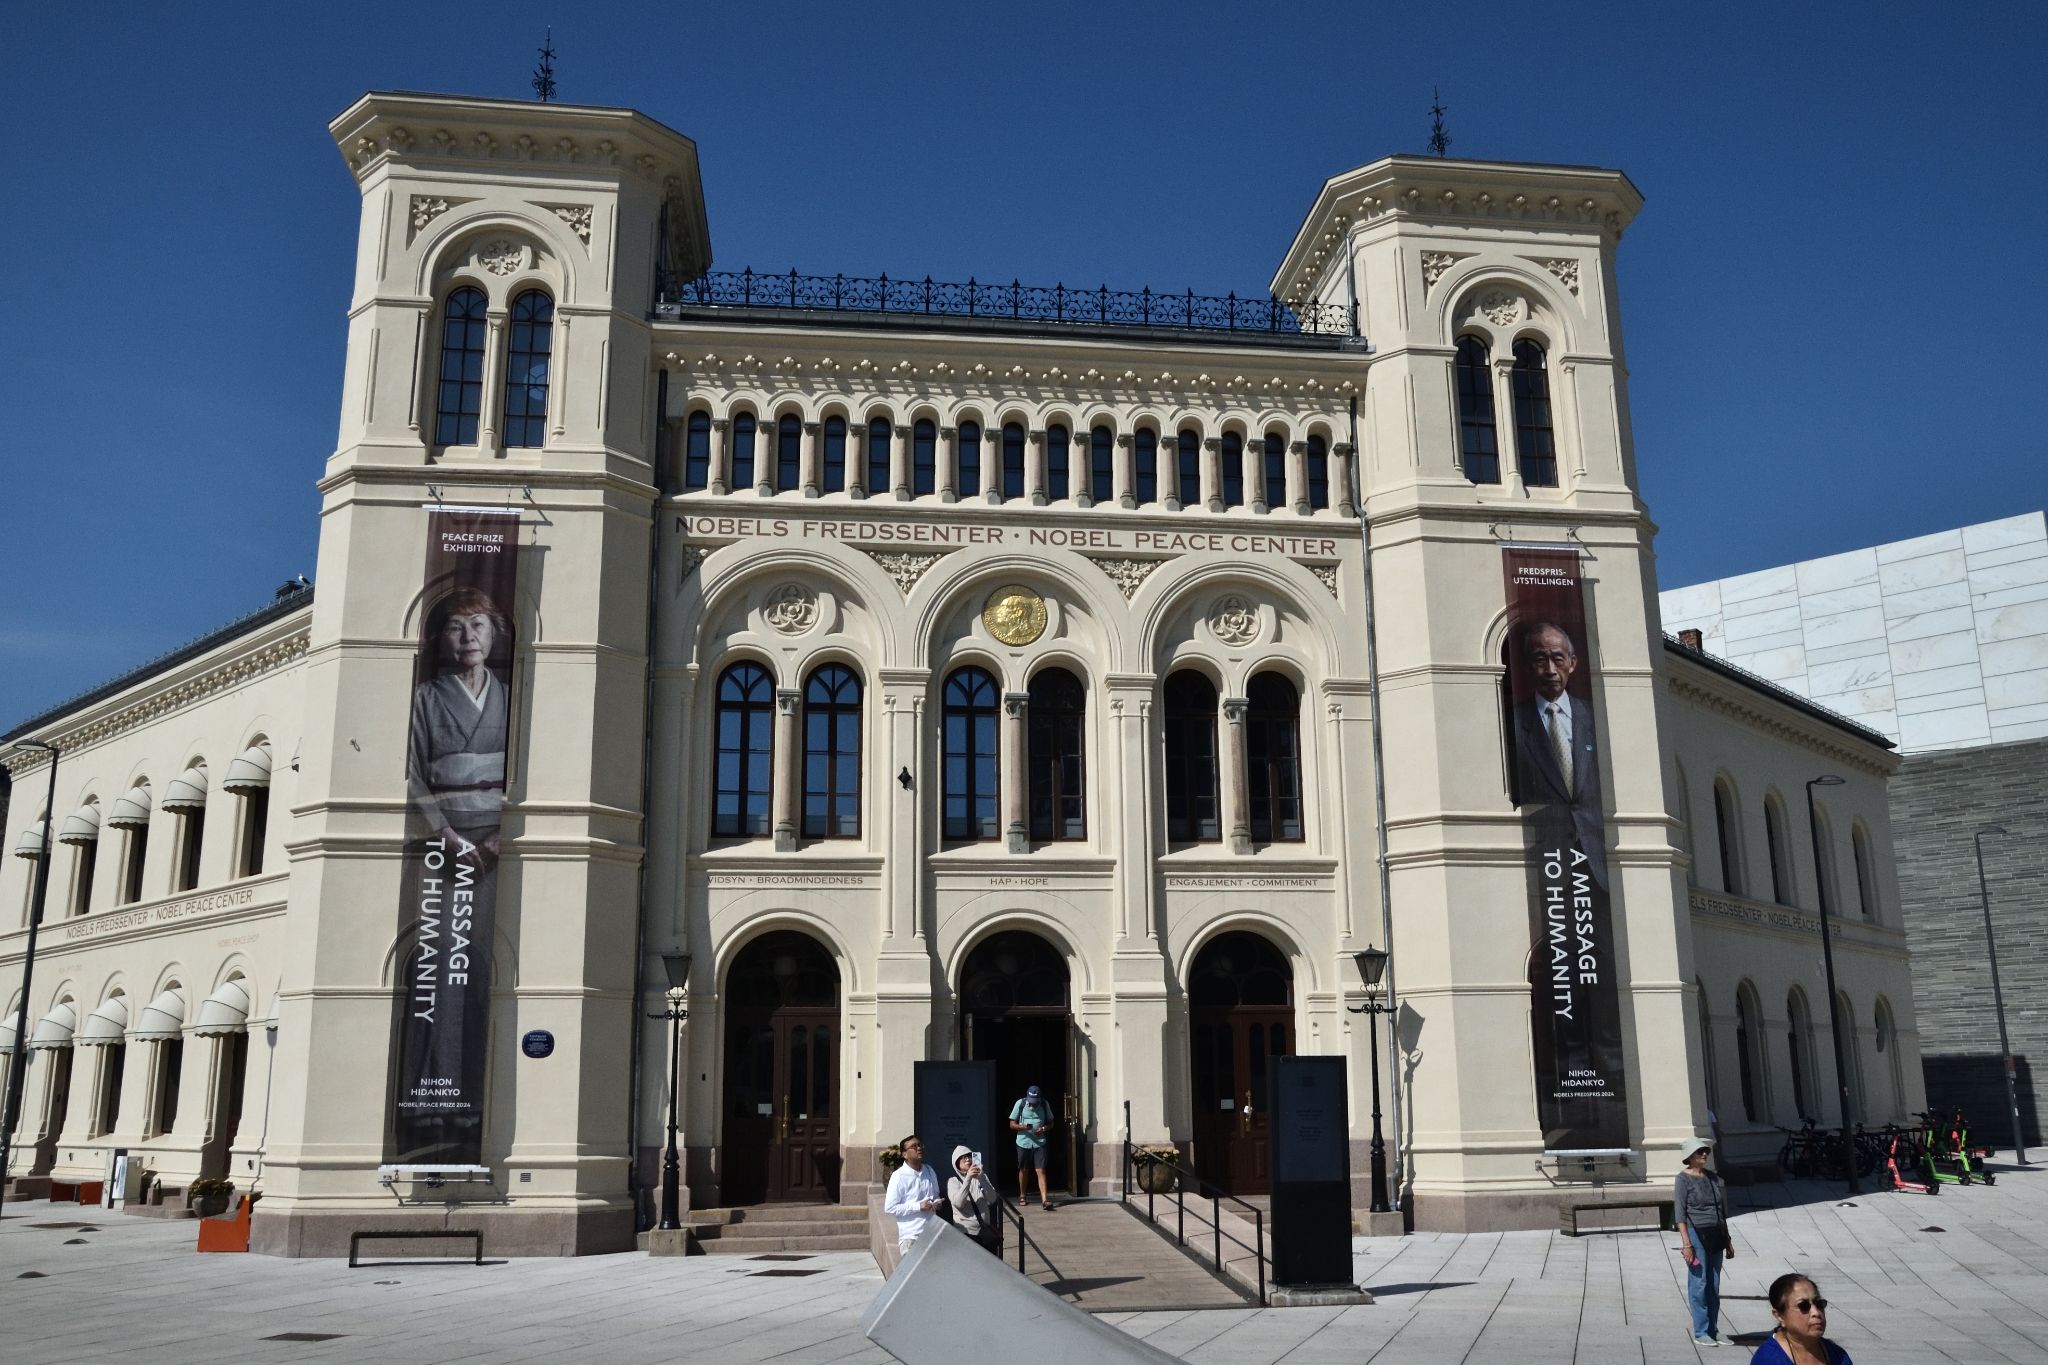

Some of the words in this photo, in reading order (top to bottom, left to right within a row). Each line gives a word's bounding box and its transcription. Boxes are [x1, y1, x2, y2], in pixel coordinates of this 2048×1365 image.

[441, 532, 475, 542] PEACE
[476, 534, 505, 543] PRIZE
[676, 516, 789, 537] NOBELS
[803, 521, 1004, 545] FREDSSENTER
[1029, 528, 1122, 548] NOBEL
[1135, 532, 1224, 551] PEACE
[1231, 536, 1336, 556] CENTER
[443, 543, 501, 553] EXHIBITION
[1518, 567, 1567, 576] FREDSPRIS-
[1513, 577, 1574, 586] UTSTILLINGEN
[424, 837, 446, 870] TO
[456, 838, 476, 858] A
[1569, 848, 1589, 867] A
[1543, 848, 1562, 879] TO
[707, 876, 746, 884] VIDSYN
[757, 876, 864, 885] BROADMINDEDNESS
[990, 878, 1012, 886] HAP
[1020, 878, 1049, 886] HOPE
[1169, 878, 1243, 887] ENGASJEMENT
[1251, 879, 1319, 887] COMMITMENT
[66, 923, 95, 940] NOBELS
[95, 911, 149, 935] FREDSSENTER
[156, 904, 183, 921] NOBEL
[185, 897, 215, 916] PEACE
[215, 889, 253, 909] CENTER
[448, 863, 475, 986] MESSAGE
[1571, 871, 1598, 985] MESSAGE
[414, 878, 443, 1023] HUMANITY
[1546, 887, 1573, 1020] HUMANITY
[1568, 1069, 1596, 1077] NIHON
[420, 1078, 452, 1086] NIHON
[1561, 1079, 1605, 1087] HIDANKYO
[410, 1088, 461, 1096] HIDANKYO
